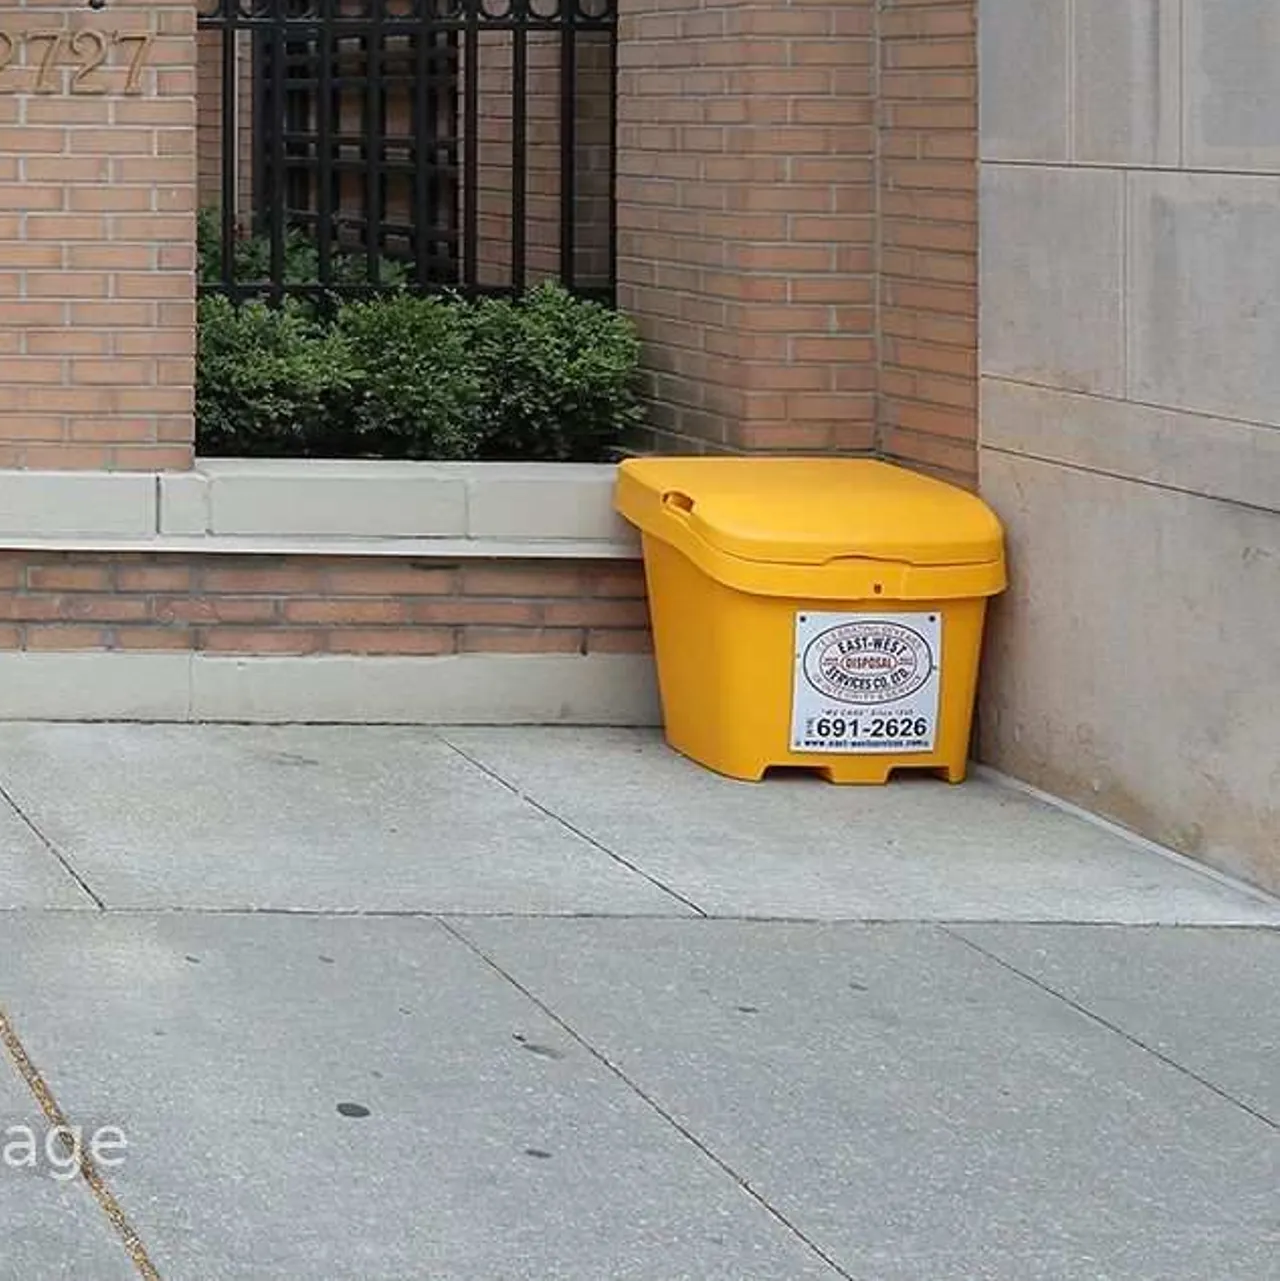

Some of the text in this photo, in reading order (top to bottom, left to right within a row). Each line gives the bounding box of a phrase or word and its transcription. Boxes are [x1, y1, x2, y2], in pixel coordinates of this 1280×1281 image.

[837, 637, 908, 656] EAST-WEST
[845, 658, 892, 670] DISPOSAL
[825, 666, 872, 690] SERVICES
[817, 717, 927, 737] 691-2626
